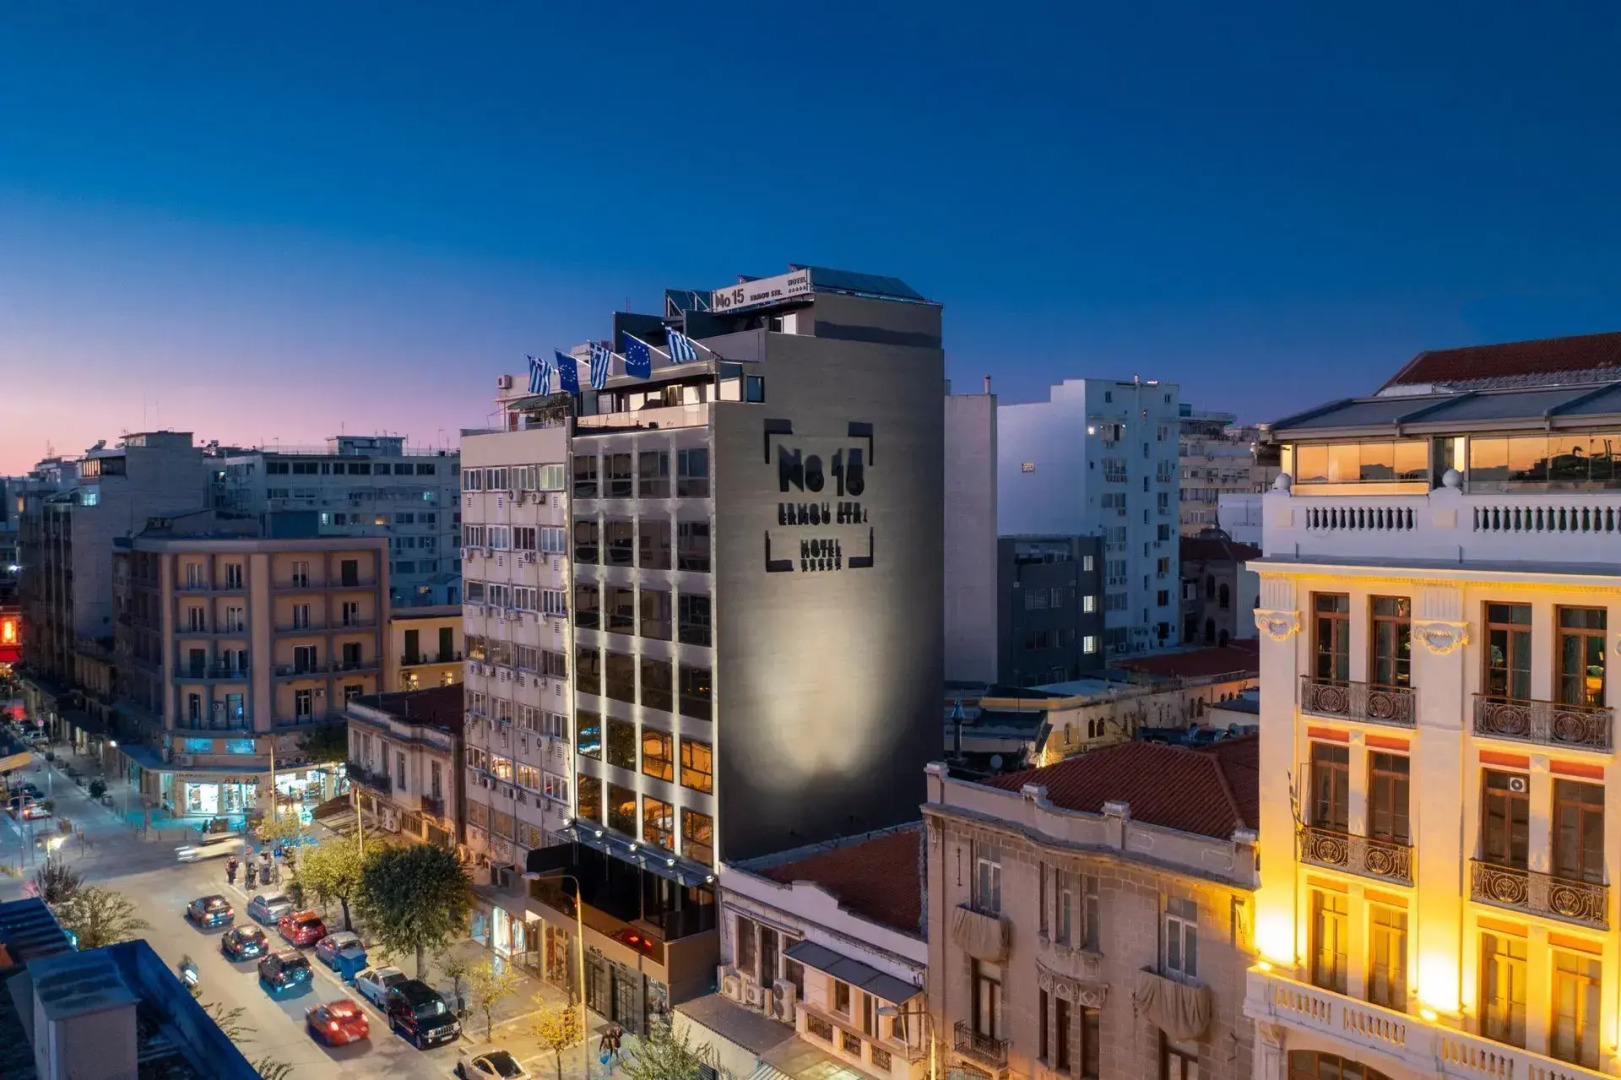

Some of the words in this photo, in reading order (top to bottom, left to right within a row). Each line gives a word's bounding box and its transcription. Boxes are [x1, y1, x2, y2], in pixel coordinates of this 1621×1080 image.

[715, 294, 731, 309] No
[732, 288, 745, 305] 15
[800, 538, 842, 558] HOTEL
